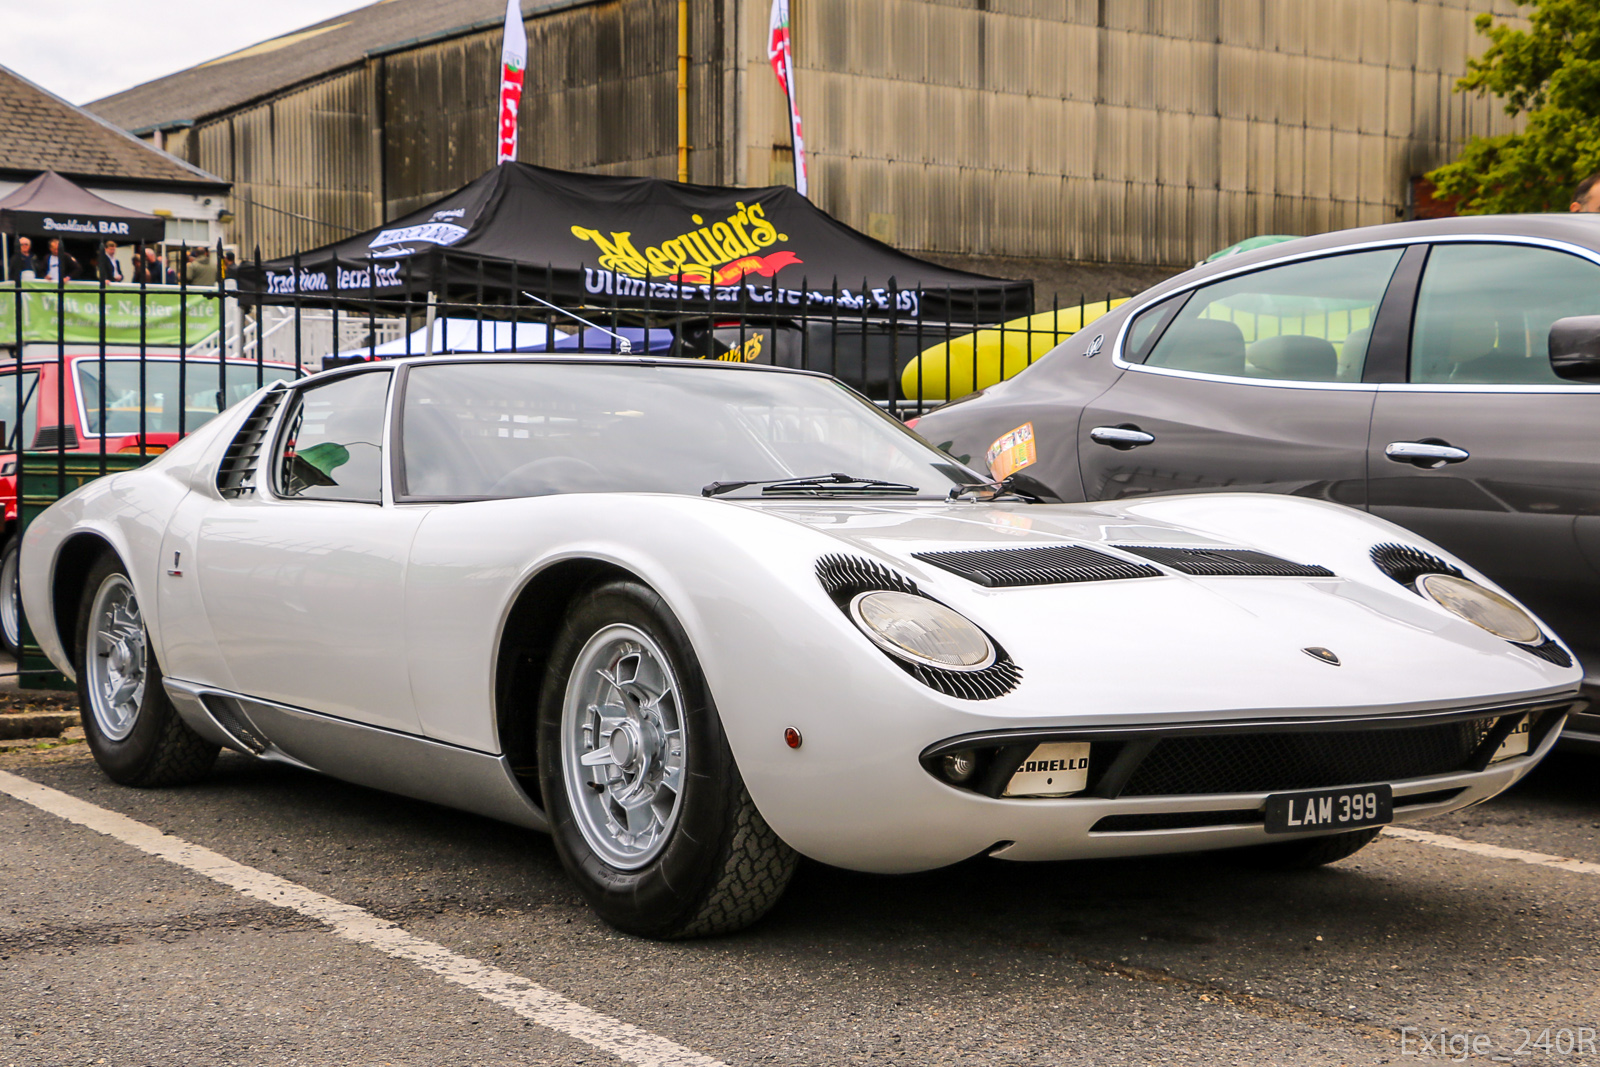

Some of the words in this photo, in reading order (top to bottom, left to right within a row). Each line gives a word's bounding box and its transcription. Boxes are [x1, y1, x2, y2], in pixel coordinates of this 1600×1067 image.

[99, 221, 129, 235] BAR
[42, 296, 80, 313] Viit
[1287, 796, 1333, 827] LAM
[1338, 792, 1377, 822] 399
